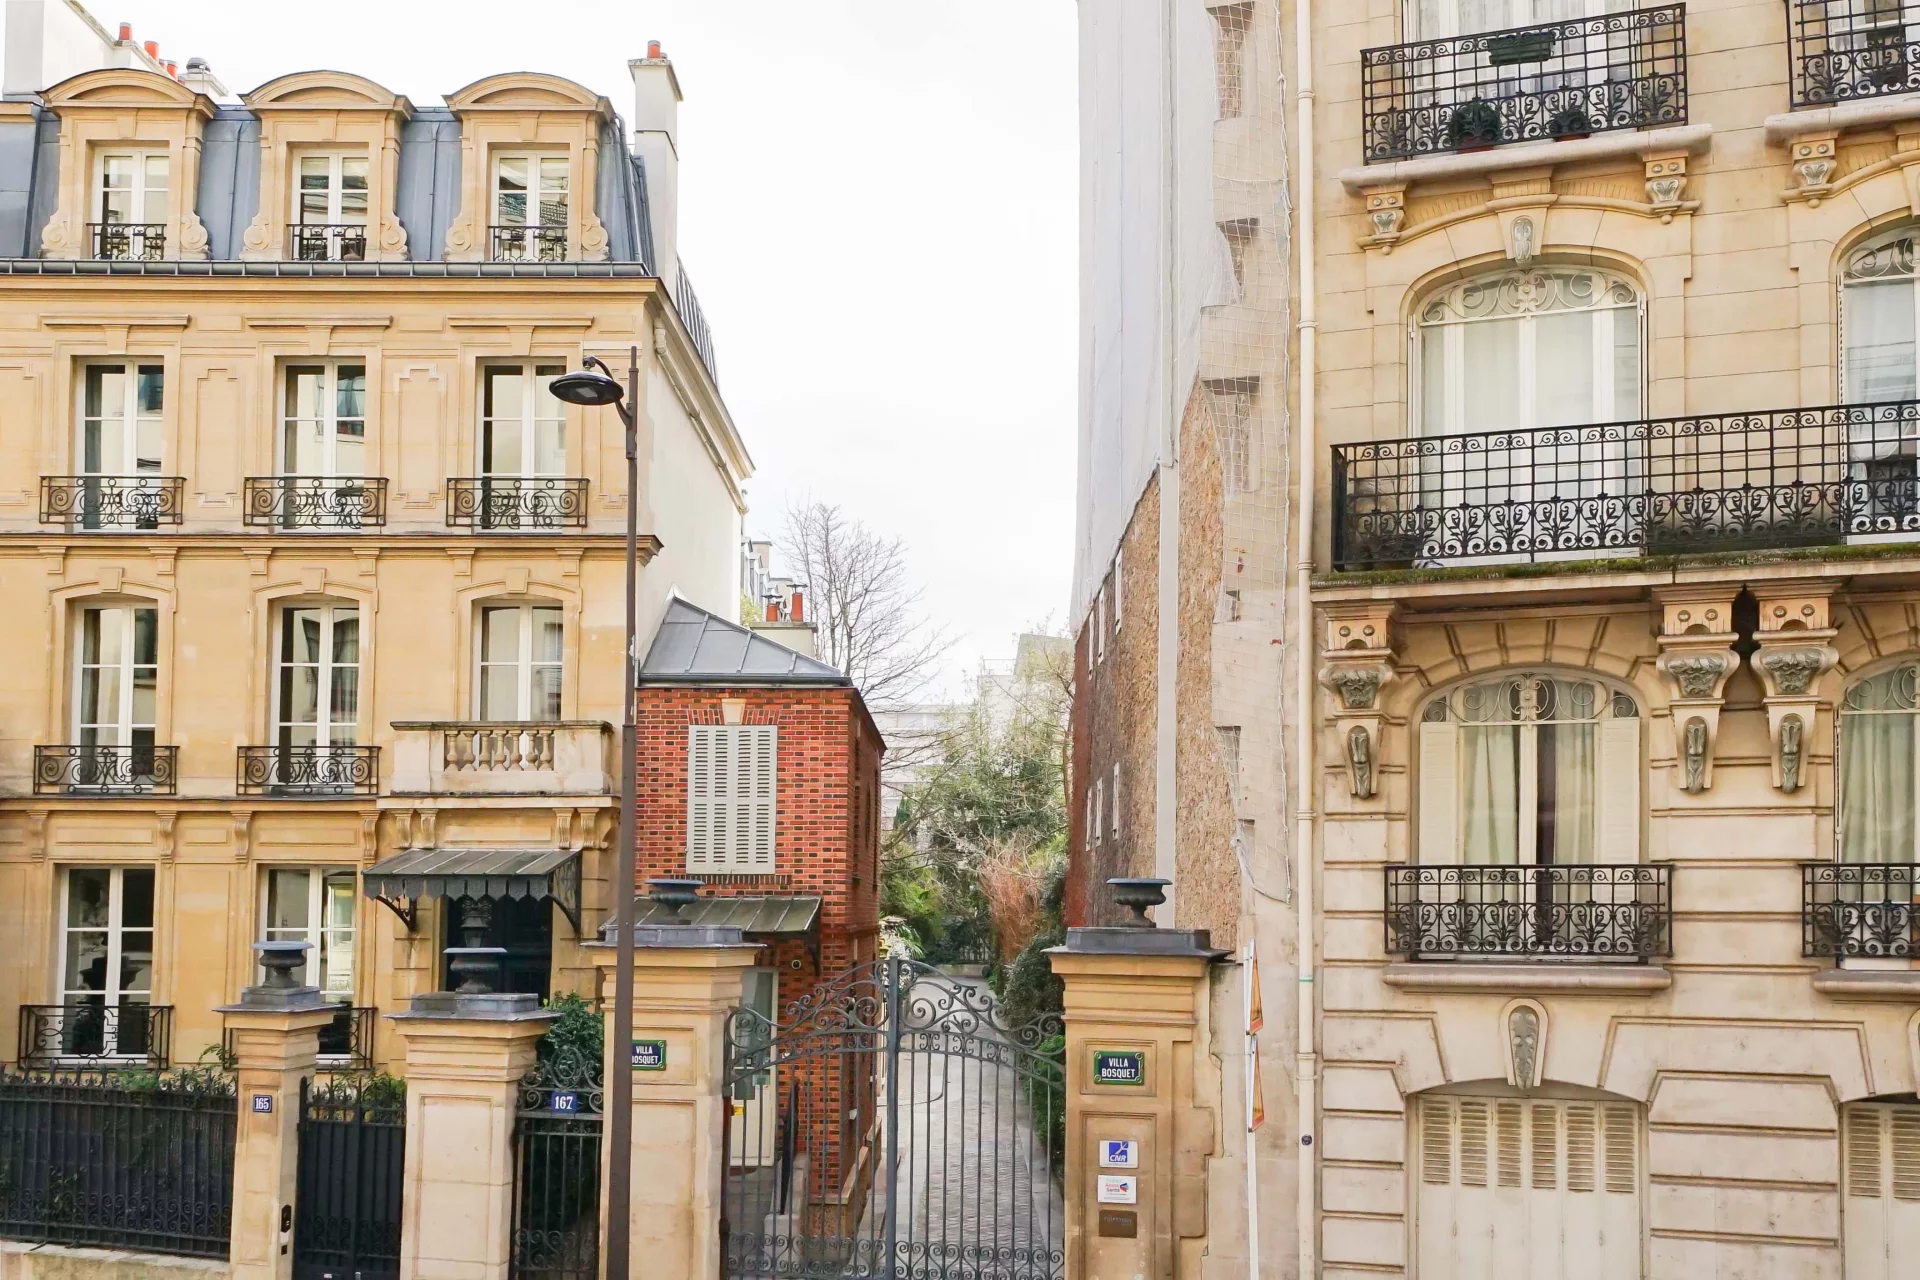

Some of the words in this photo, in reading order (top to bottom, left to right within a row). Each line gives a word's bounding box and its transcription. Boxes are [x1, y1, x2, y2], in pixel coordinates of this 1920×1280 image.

[635, 1045, 653, 1055] VILLA
[1108, 1057, 1129, 1067] VILLA
[1101, 1068, 1136, 1078] BOSQUET
[255, 1097, 269, 1110] 165
[554, 1095, 574, 1110] 167
[1109, 1154, 1127, 1162] CNR
